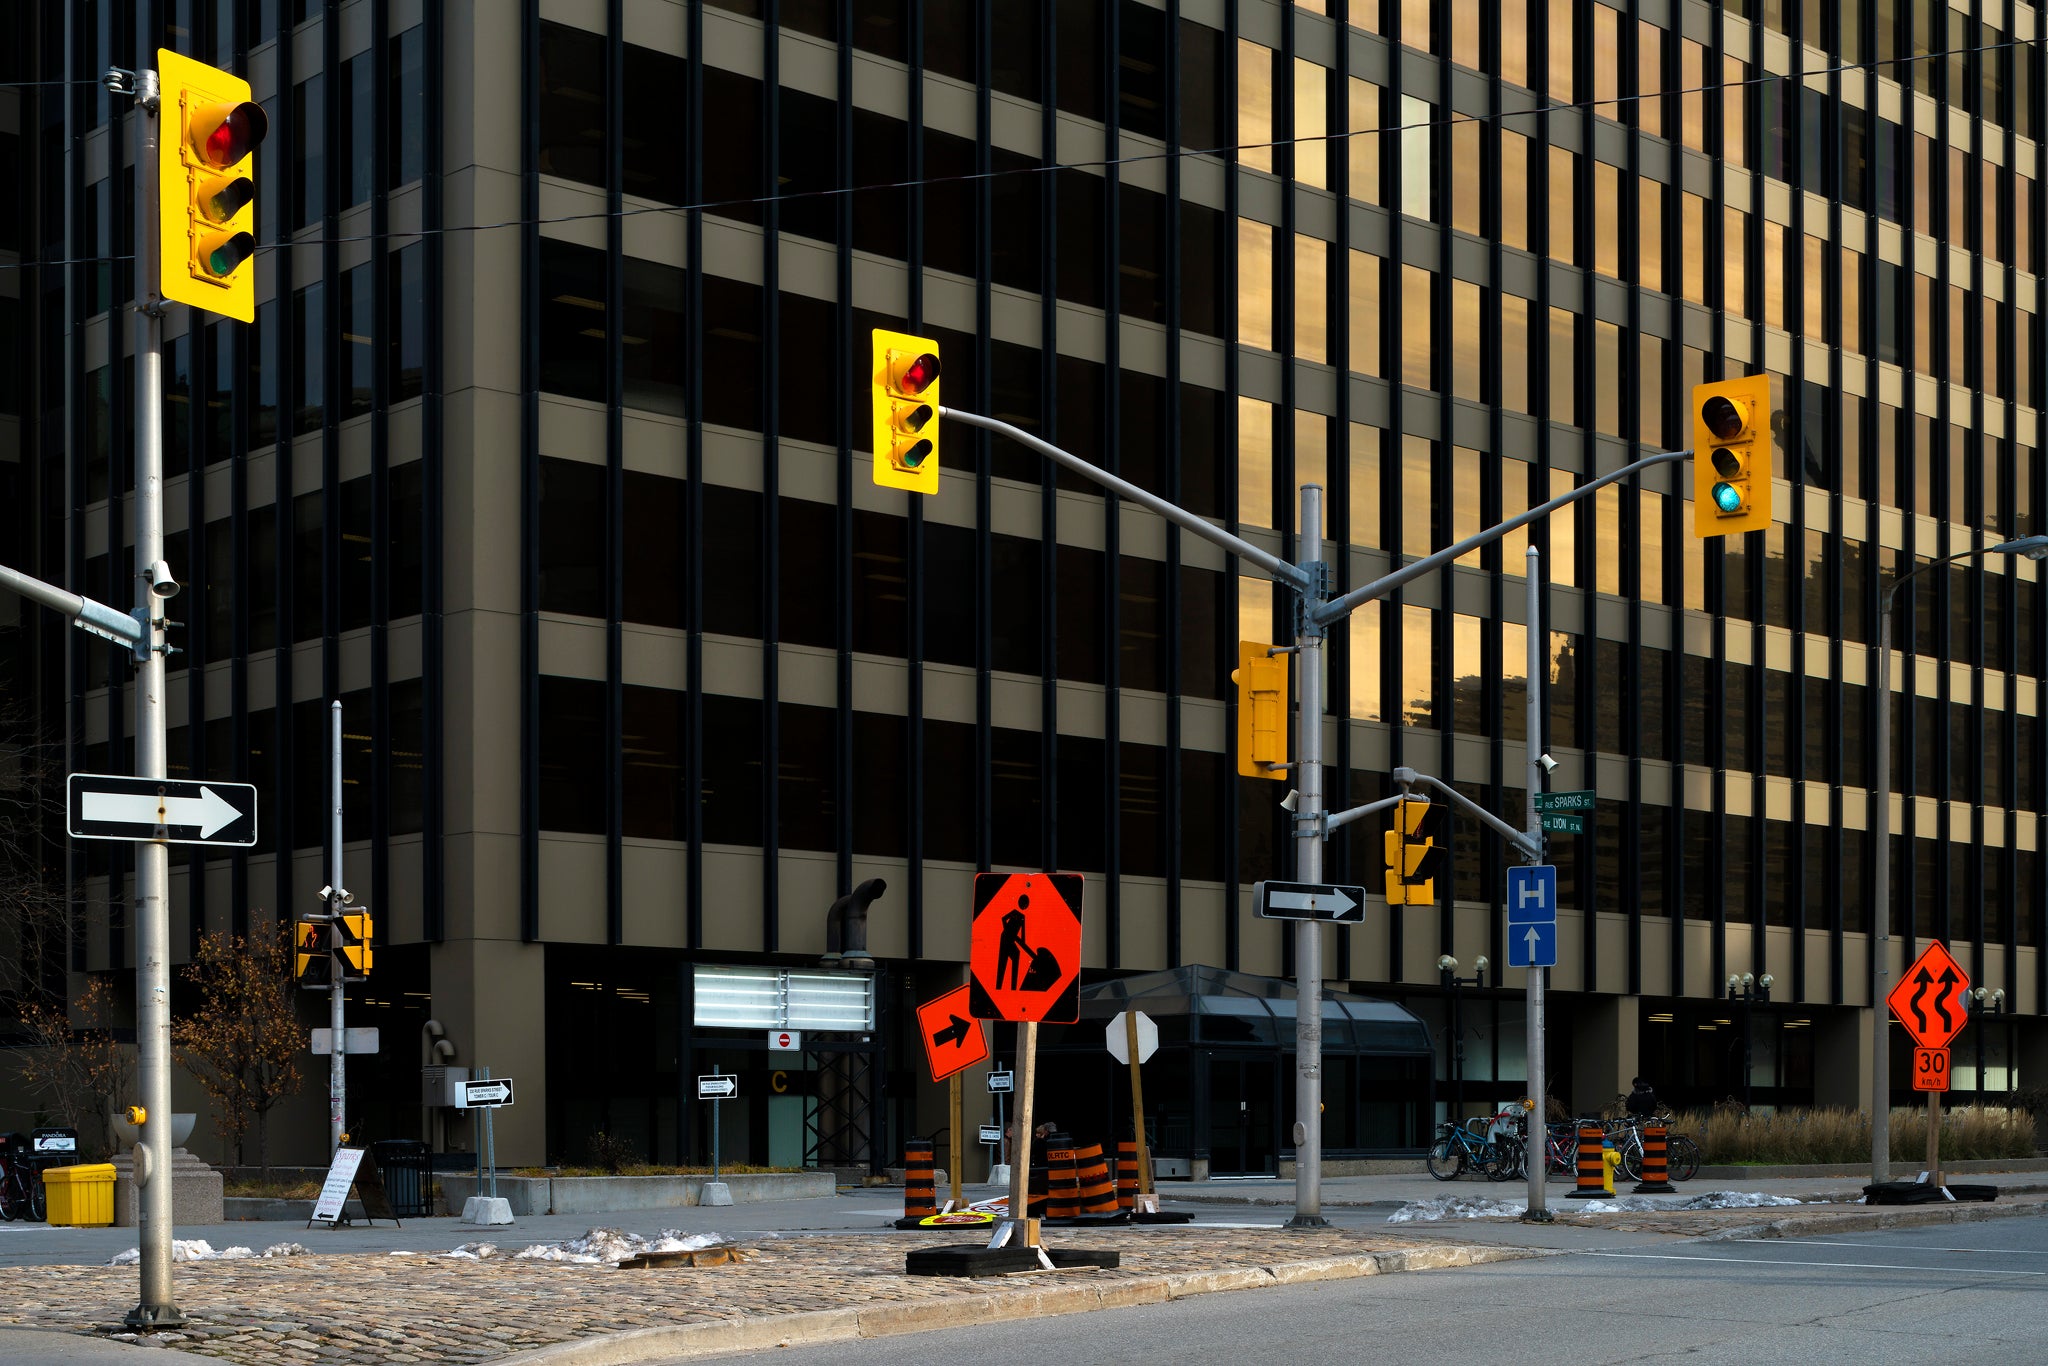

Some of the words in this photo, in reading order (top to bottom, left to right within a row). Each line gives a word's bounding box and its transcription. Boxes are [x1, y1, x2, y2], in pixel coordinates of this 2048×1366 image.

[1554, 795, 1582, 808] SPARKS
[1553, 817, 1567, 829] LYON
[1519, 879, 1544, 908] H
[1919, 1052, 1945, 1073] 30
[772, 1070, 787, 1093] C
[1921, 1077, 1941, 1087] km/h
